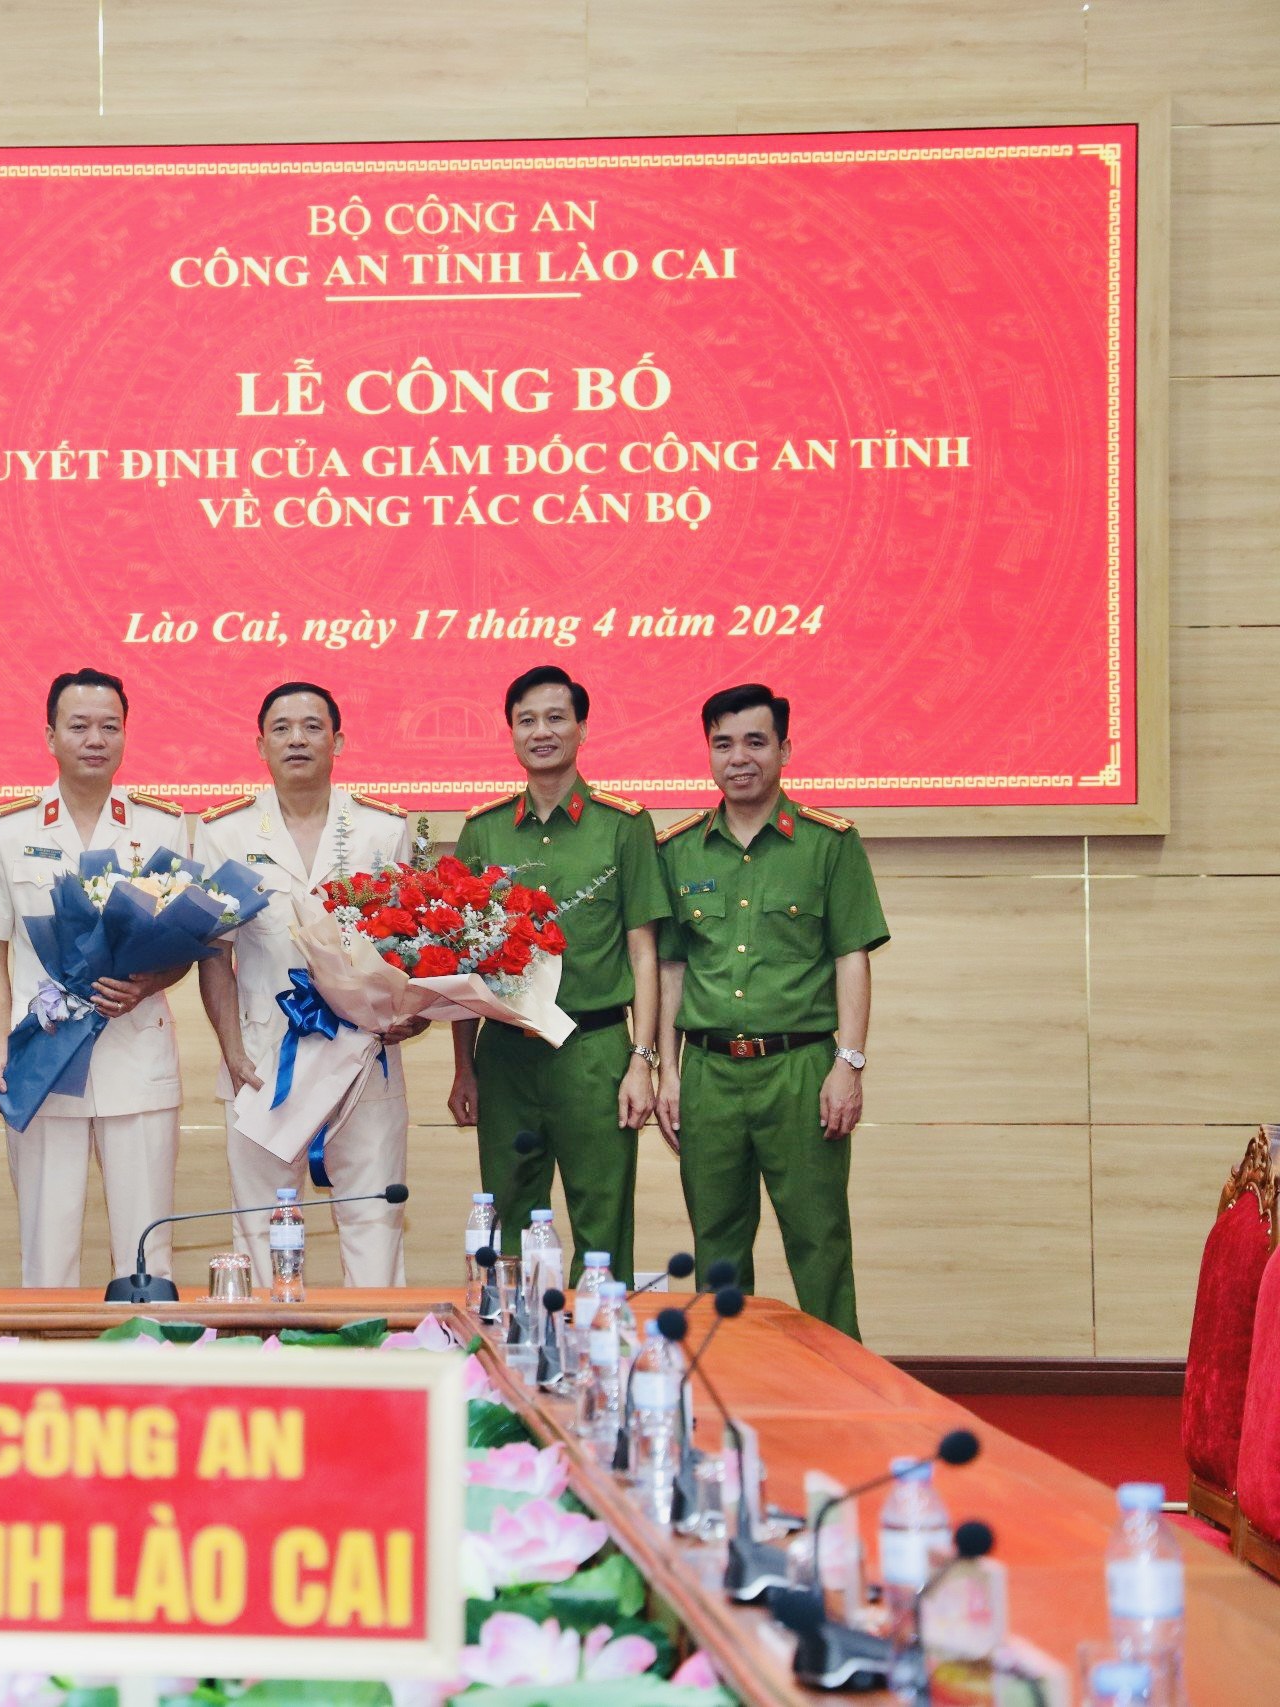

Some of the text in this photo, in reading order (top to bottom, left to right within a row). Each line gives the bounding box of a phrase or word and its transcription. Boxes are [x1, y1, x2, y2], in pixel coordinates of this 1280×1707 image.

[308, 194, 597, 241] BỘ CÔNG AN
[170, 242, 737, 288] CÔNG AN TỈNH LÀO CAI
[236, 352, 671, 416] LỄ CÔNG BỐ
[120, 447, 239, 487] ĐỊNH
[251, 439, 350, 479] CỦA
[362, 437, 492, 477] GIÁM
[504, 432, 607, 474] ĐỐC
[619, 432, 759, 474] CÔNG
[772, 440, 838, 471] AN
[850, 429, 970, 468] TỈNH
[198, 484, 711, 530] VỀ CÔNG TÁC CÁN BỘ
[122, 604, 824, 650] Lào Cai, ngày 17 tháng 4 năm 2024
[196, 1407, 306, 1480] AN
[88, 1503, 248, 1625] LÀO
[272, 1527, 414, 1628] CAI
